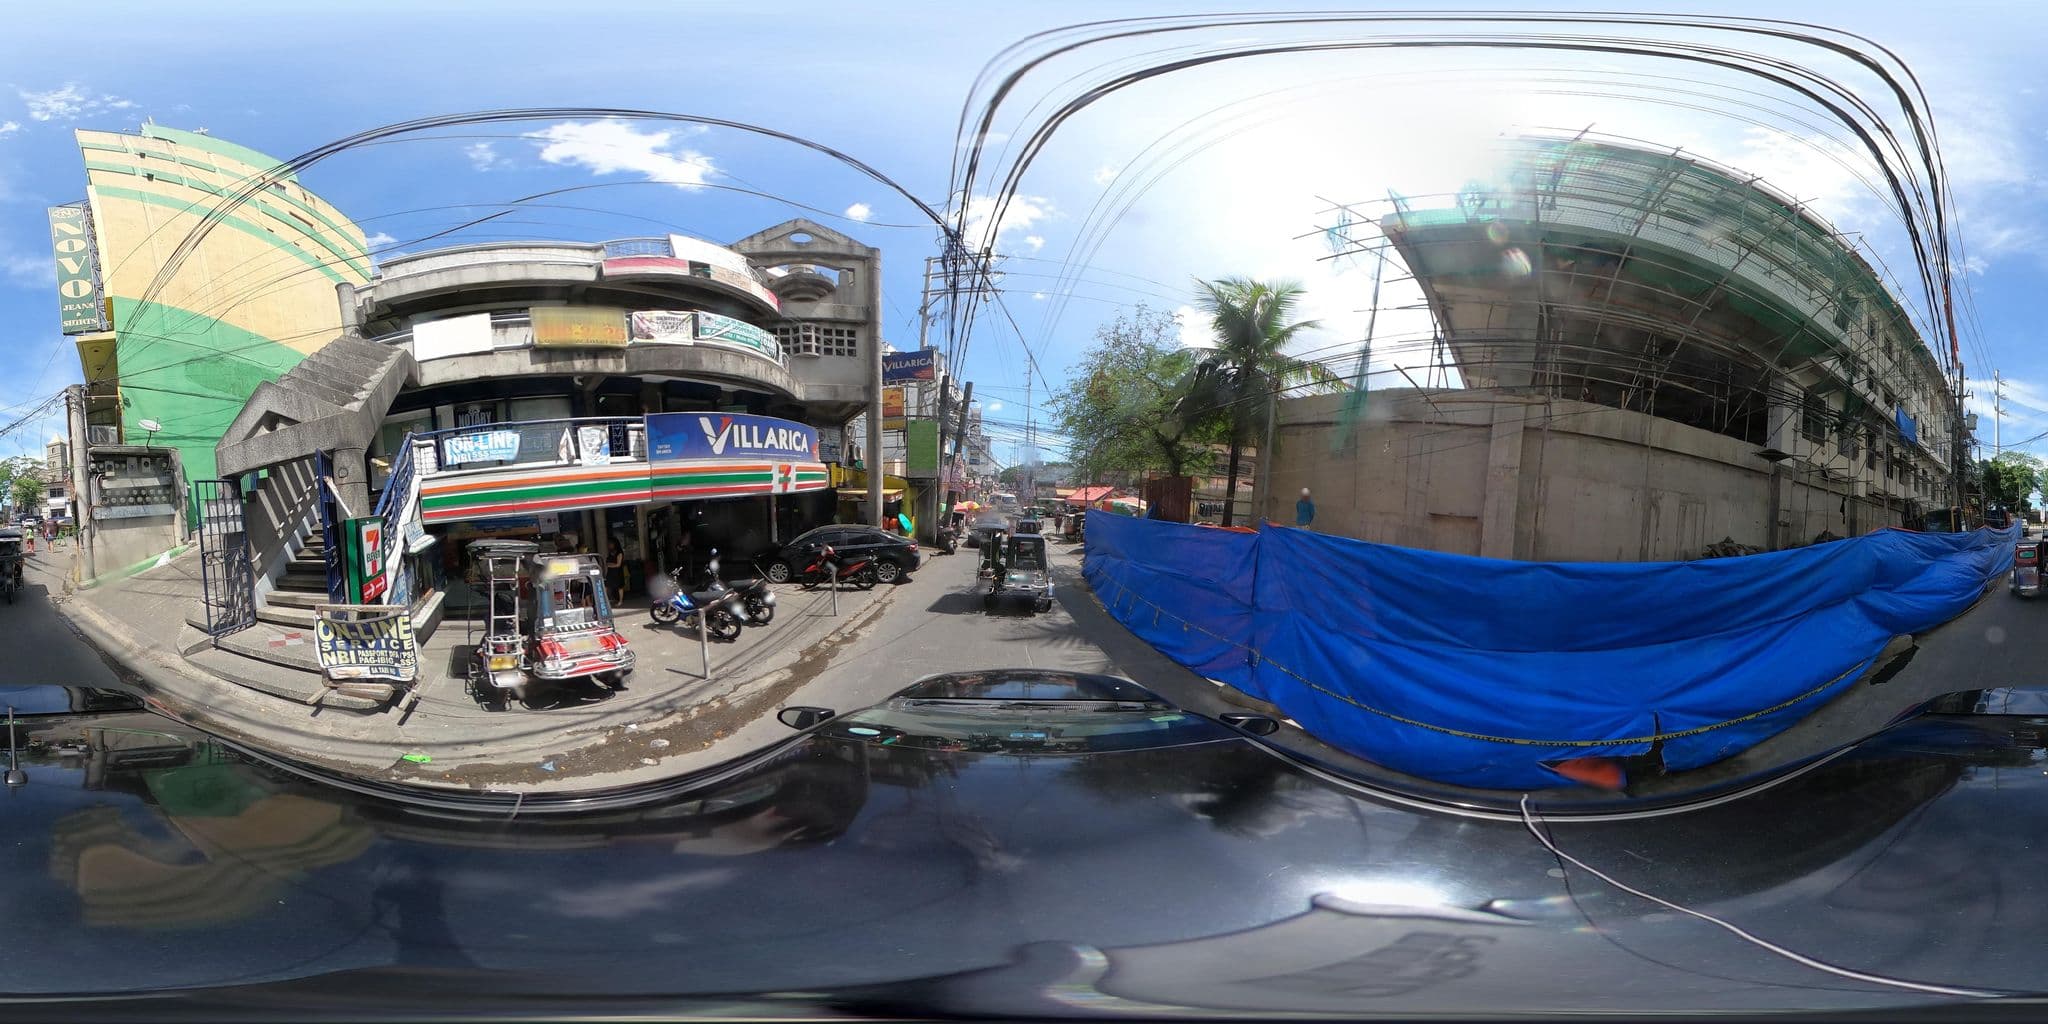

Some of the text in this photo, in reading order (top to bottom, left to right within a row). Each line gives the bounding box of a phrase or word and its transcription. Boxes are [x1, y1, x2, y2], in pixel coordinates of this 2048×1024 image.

[53, 221, 93, 298] NOVO
[63, 303, 95, 311] JEANS
[62, 317, 98, 327] SHIRTS
[882, 358, 933, 372] VILLARICA
[458, 411, 492, 427] NOTARY
[699, 416, 809, 455] VILLARICA
[317, 615, 412, 642] ON-LINE
[321, 639, 413, 651] SERVICE
[322, 650, 357, 666] NBI
[359, 656, 394, 665] PAG-IBIG
[1591, 737, 1642, 747] CAUTION
